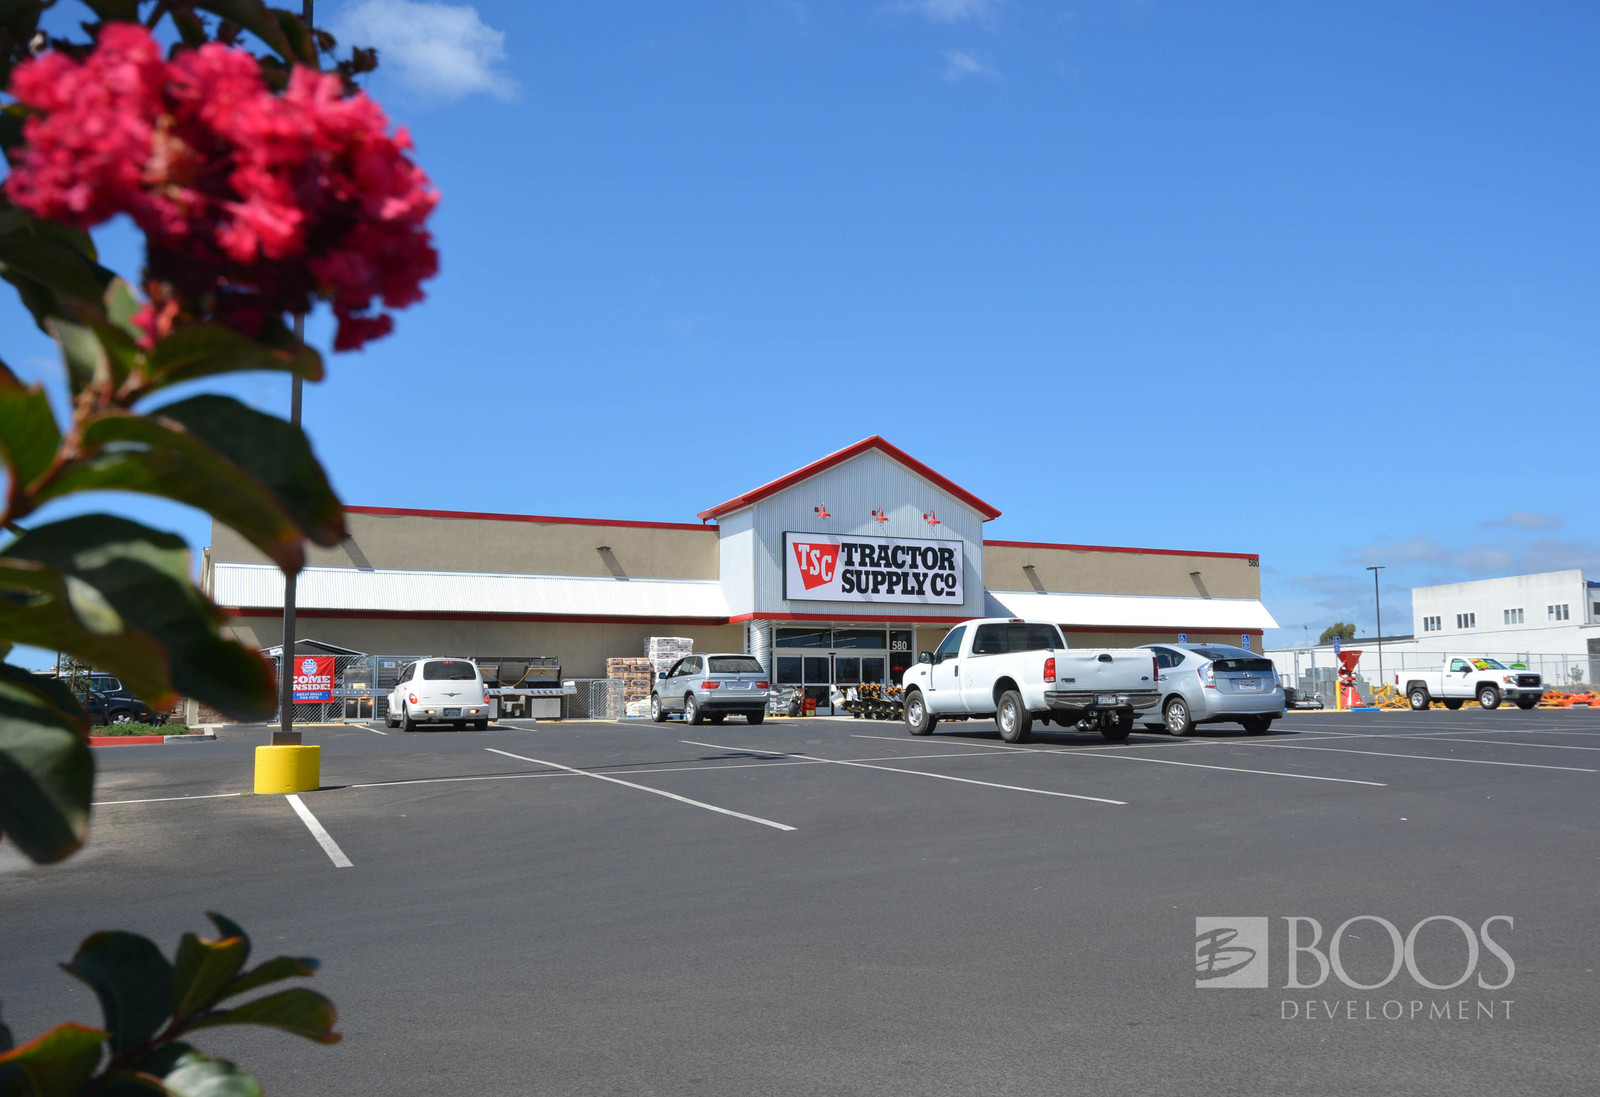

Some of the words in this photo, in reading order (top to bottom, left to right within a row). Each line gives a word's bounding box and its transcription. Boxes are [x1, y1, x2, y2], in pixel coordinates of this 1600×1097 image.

[798, 544, 833, 582] TSC
[841, 542, 956, 571] TRACTOR
[1248, 558, 1259, 568] 580
[841, 569, 928, 596] SUPPLY
[892, 640, 907, 650] 580
